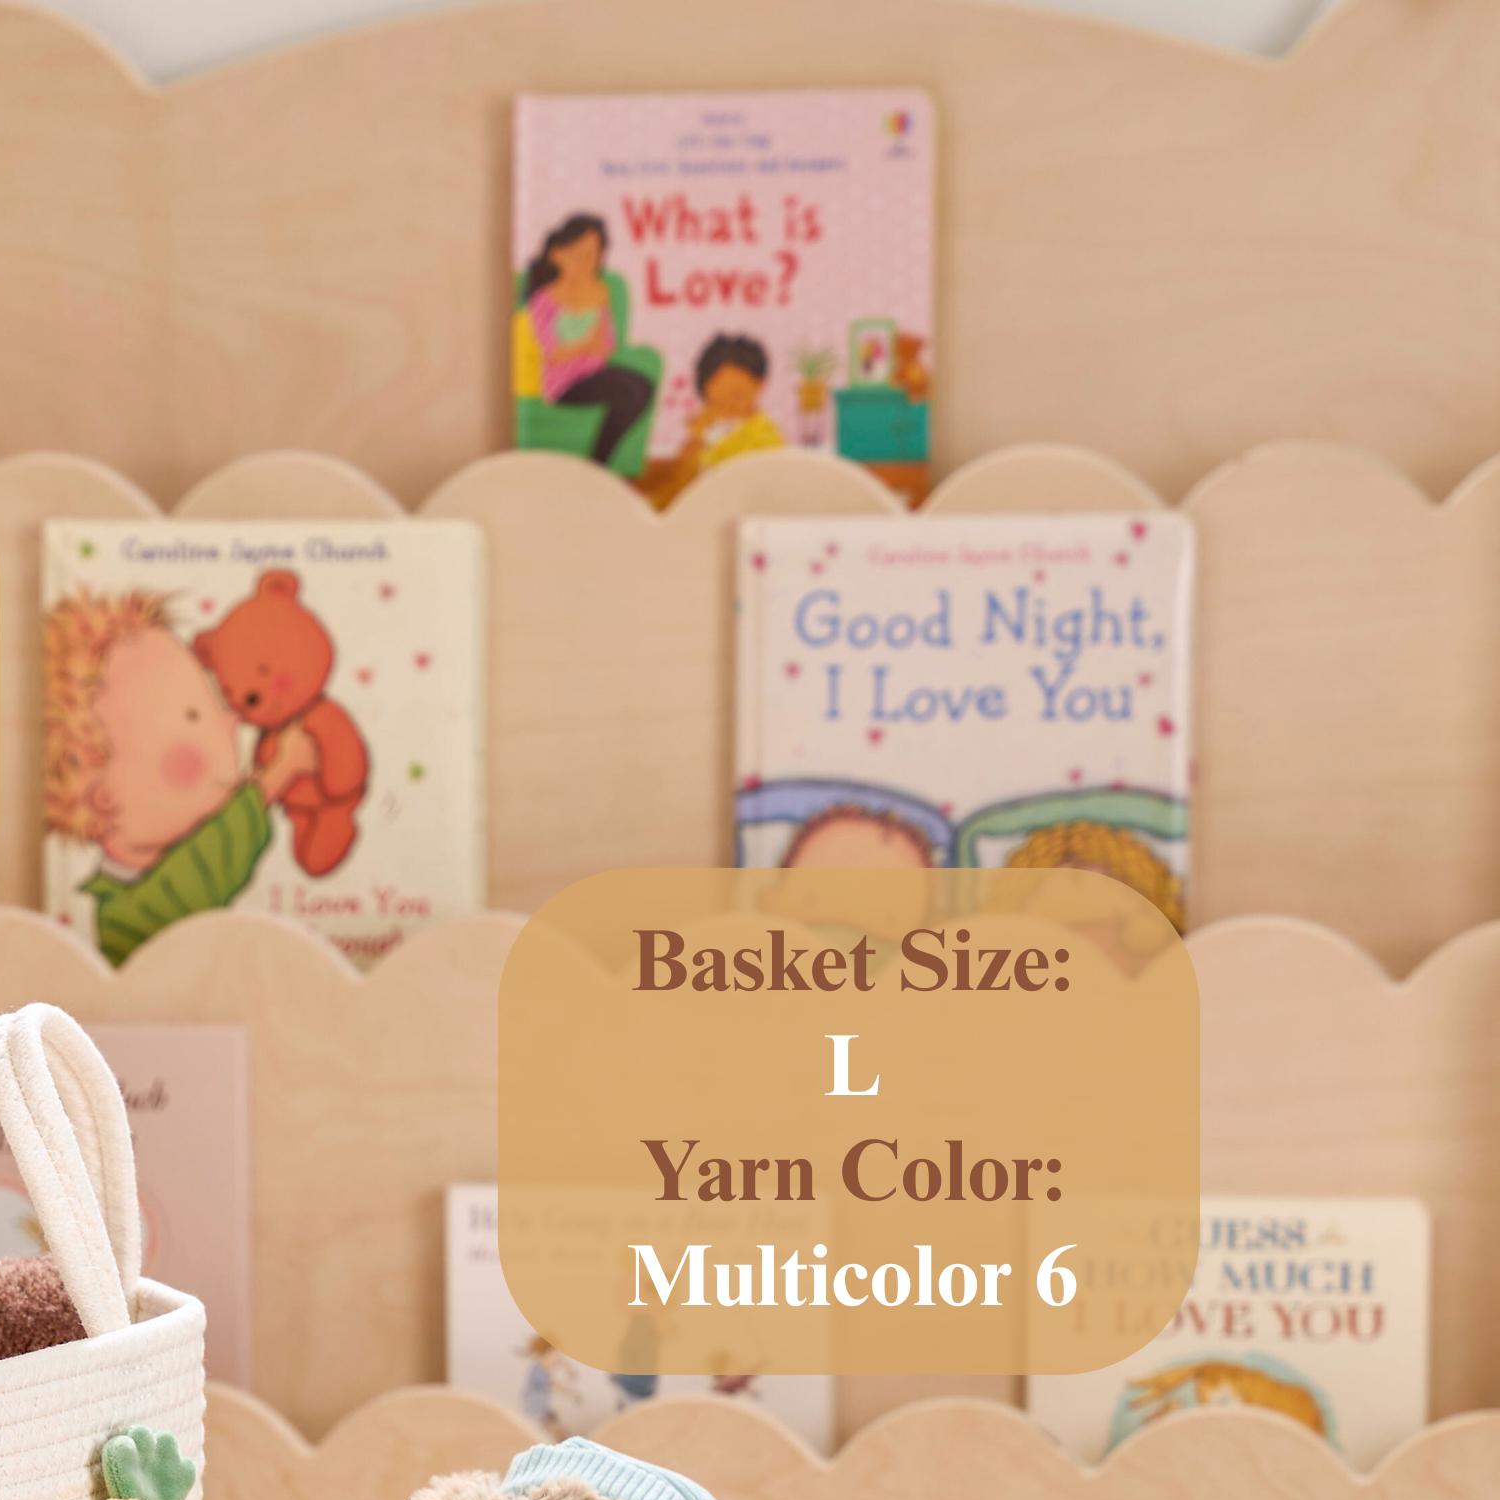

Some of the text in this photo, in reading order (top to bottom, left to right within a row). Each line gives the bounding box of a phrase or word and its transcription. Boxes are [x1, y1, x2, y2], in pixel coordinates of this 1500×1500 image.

[619, 194, 823, 244] What is
[644, 252, 800, 308] Love?
[794, 586, 1166, 658] Good Night,
[825, 660, 1136, 723] I Love You
[1220, 1260, 1375, 1293] MUCH
[1114, 1301, 1255, 1339] LOVE
[1272, 1302, 1386, 1342] YOU
